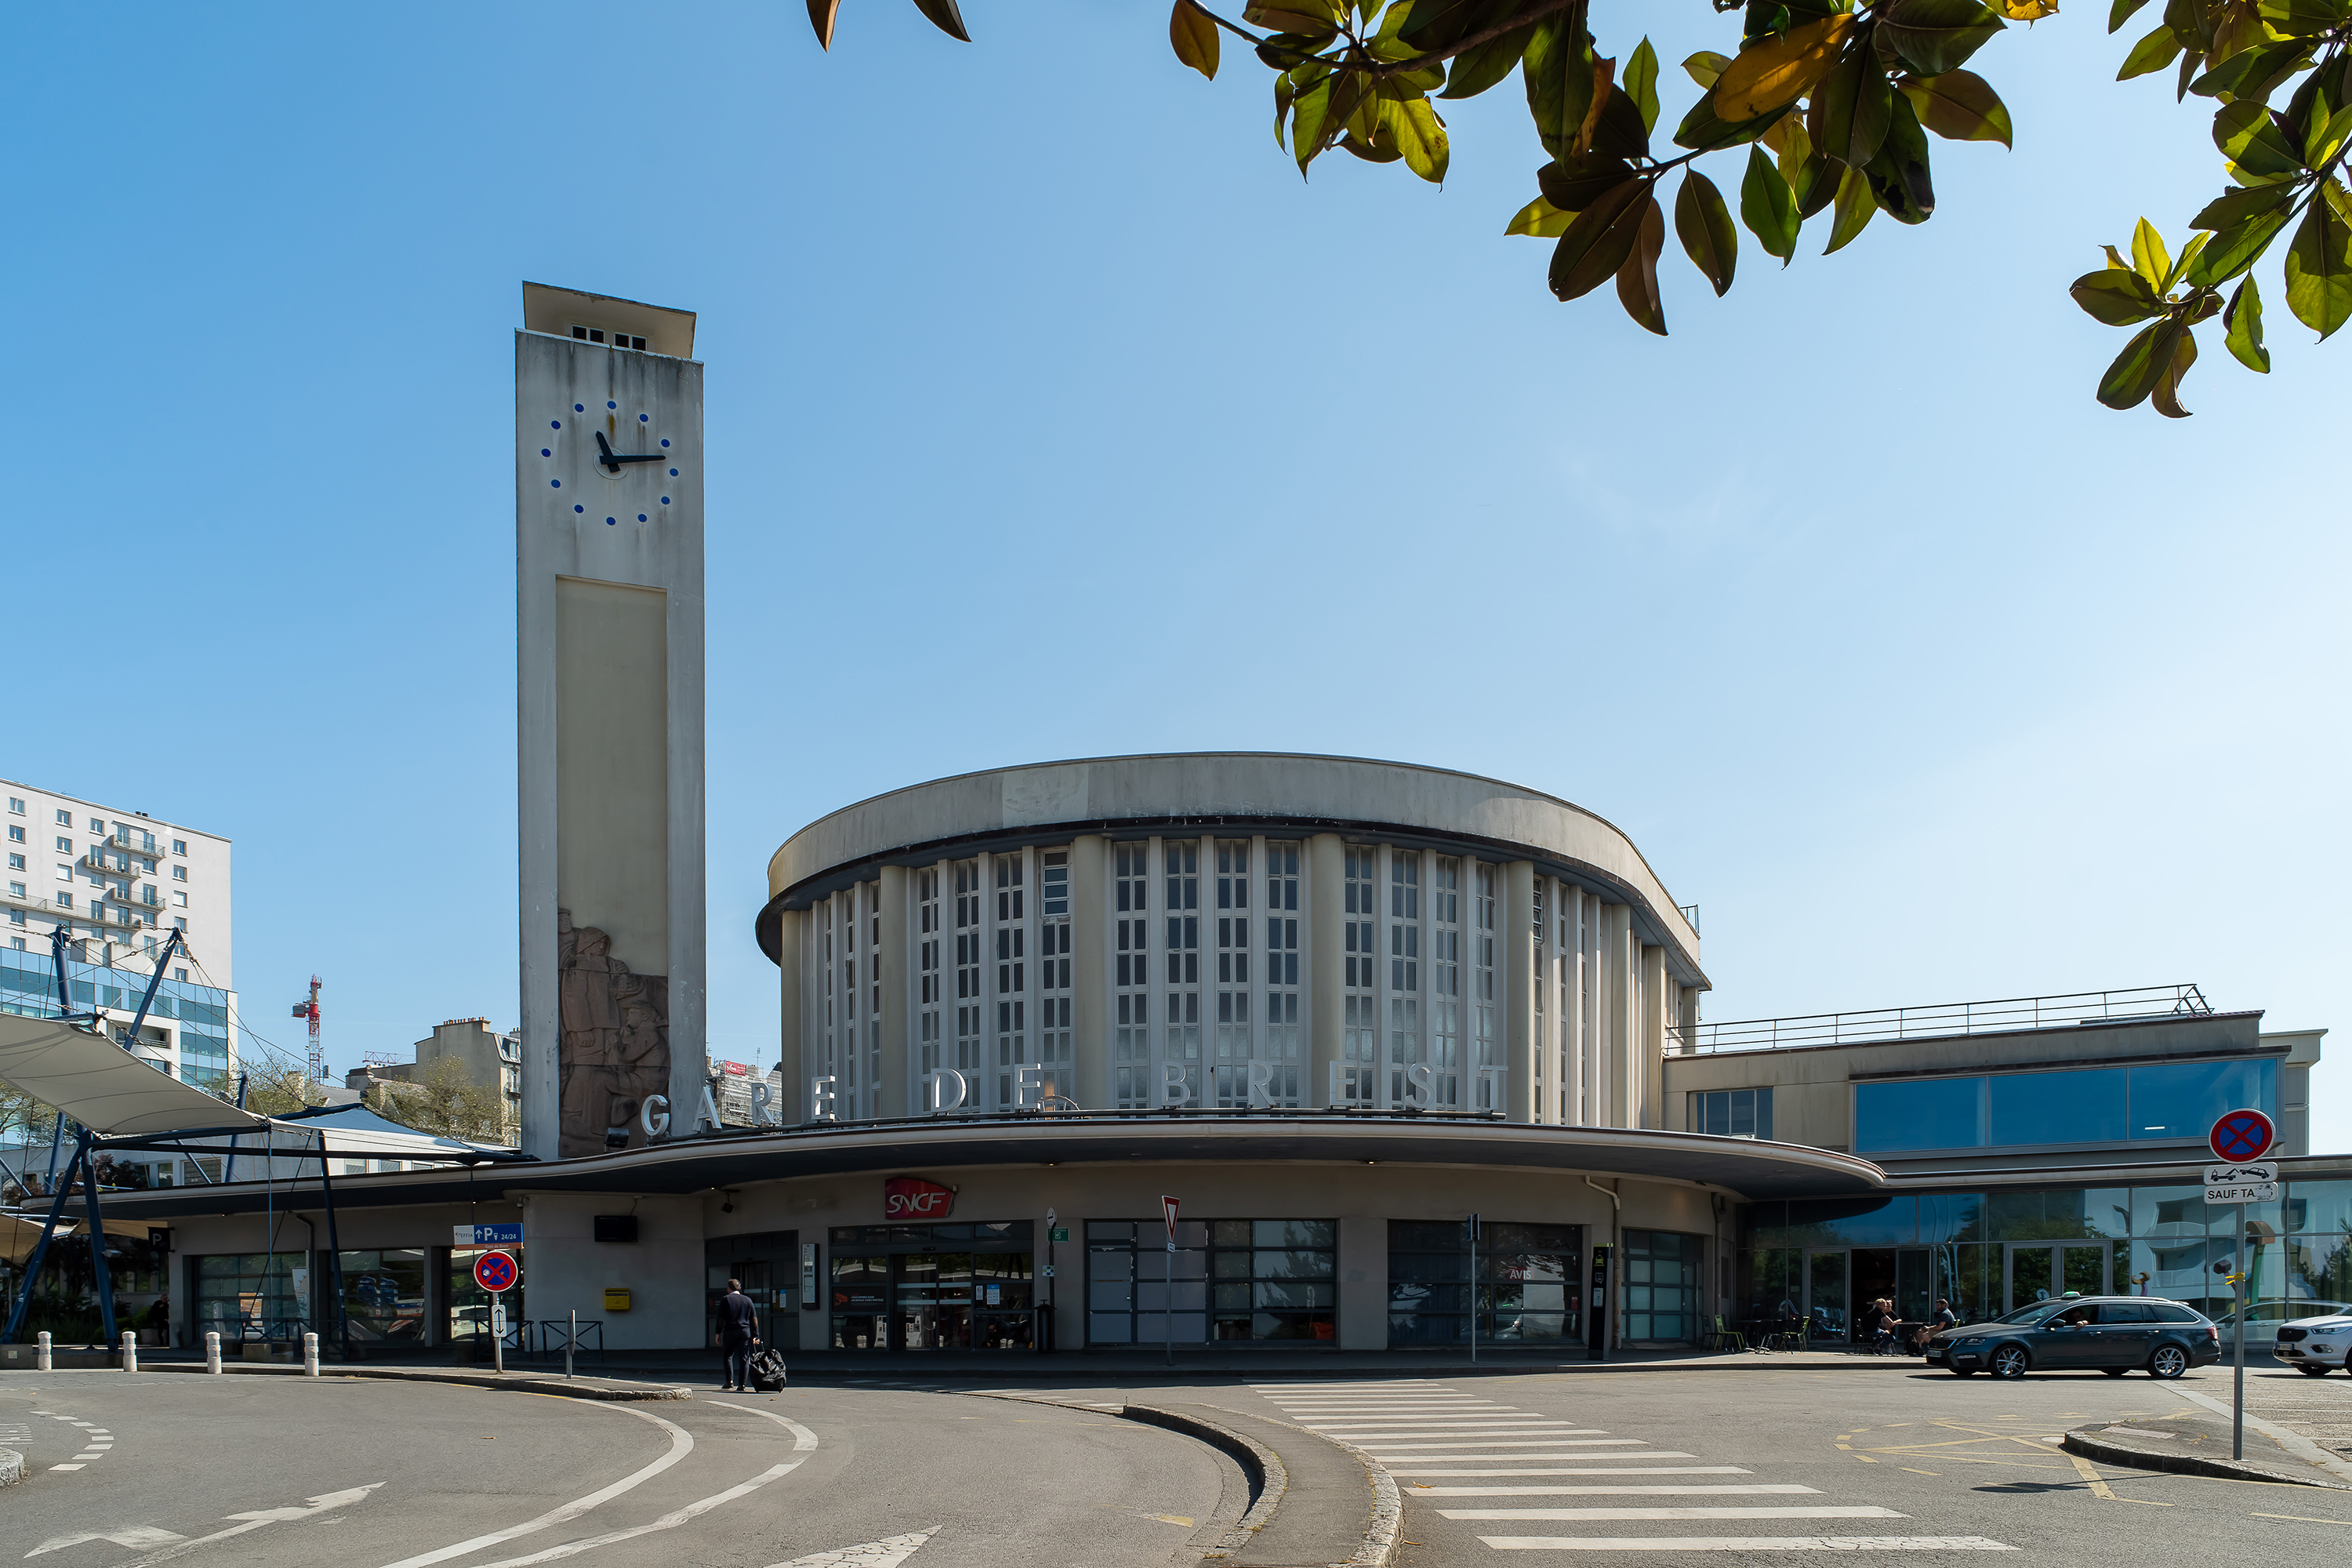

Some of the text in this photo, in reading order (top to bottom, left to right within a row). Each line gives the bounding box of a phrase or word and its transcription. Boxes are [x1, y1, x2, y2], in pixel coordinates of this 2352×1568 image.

[641, 1059, 1509, 1137] GARE DE BREST
[2208, 1189, 2238, 1200] SAUF
[887, 1192, 946, 1213] SNCF
[152, 1232, 162, 1246] P
[484, 1228, 493, 1241] P
[1510, 1270, 1531, 1279] AVIS
